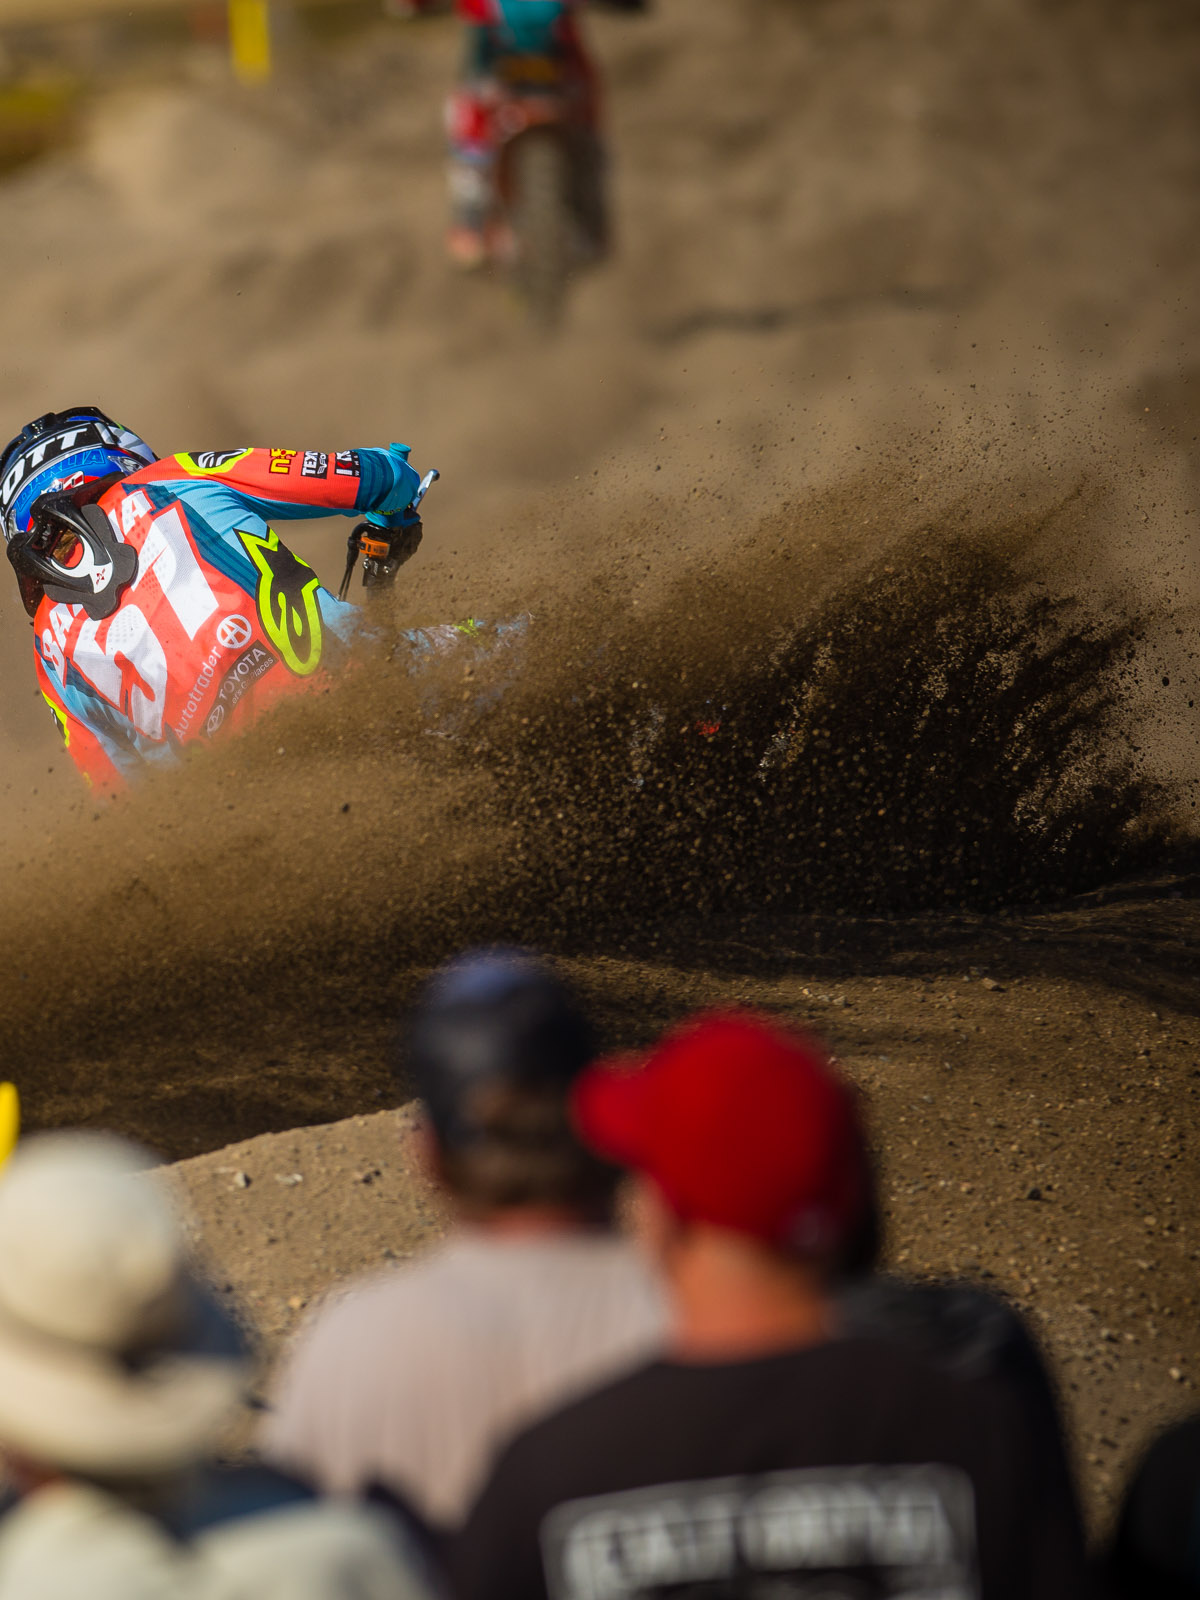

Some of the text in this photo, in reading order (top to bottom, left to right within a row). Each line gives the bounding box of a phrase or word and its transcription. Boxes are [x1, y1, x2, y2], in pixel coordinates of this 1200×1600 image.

[73, 506, 220, 740] 51
[174, 646, 222, 741] Autotrader
[218, 648, 267, 701] TOYOTA
